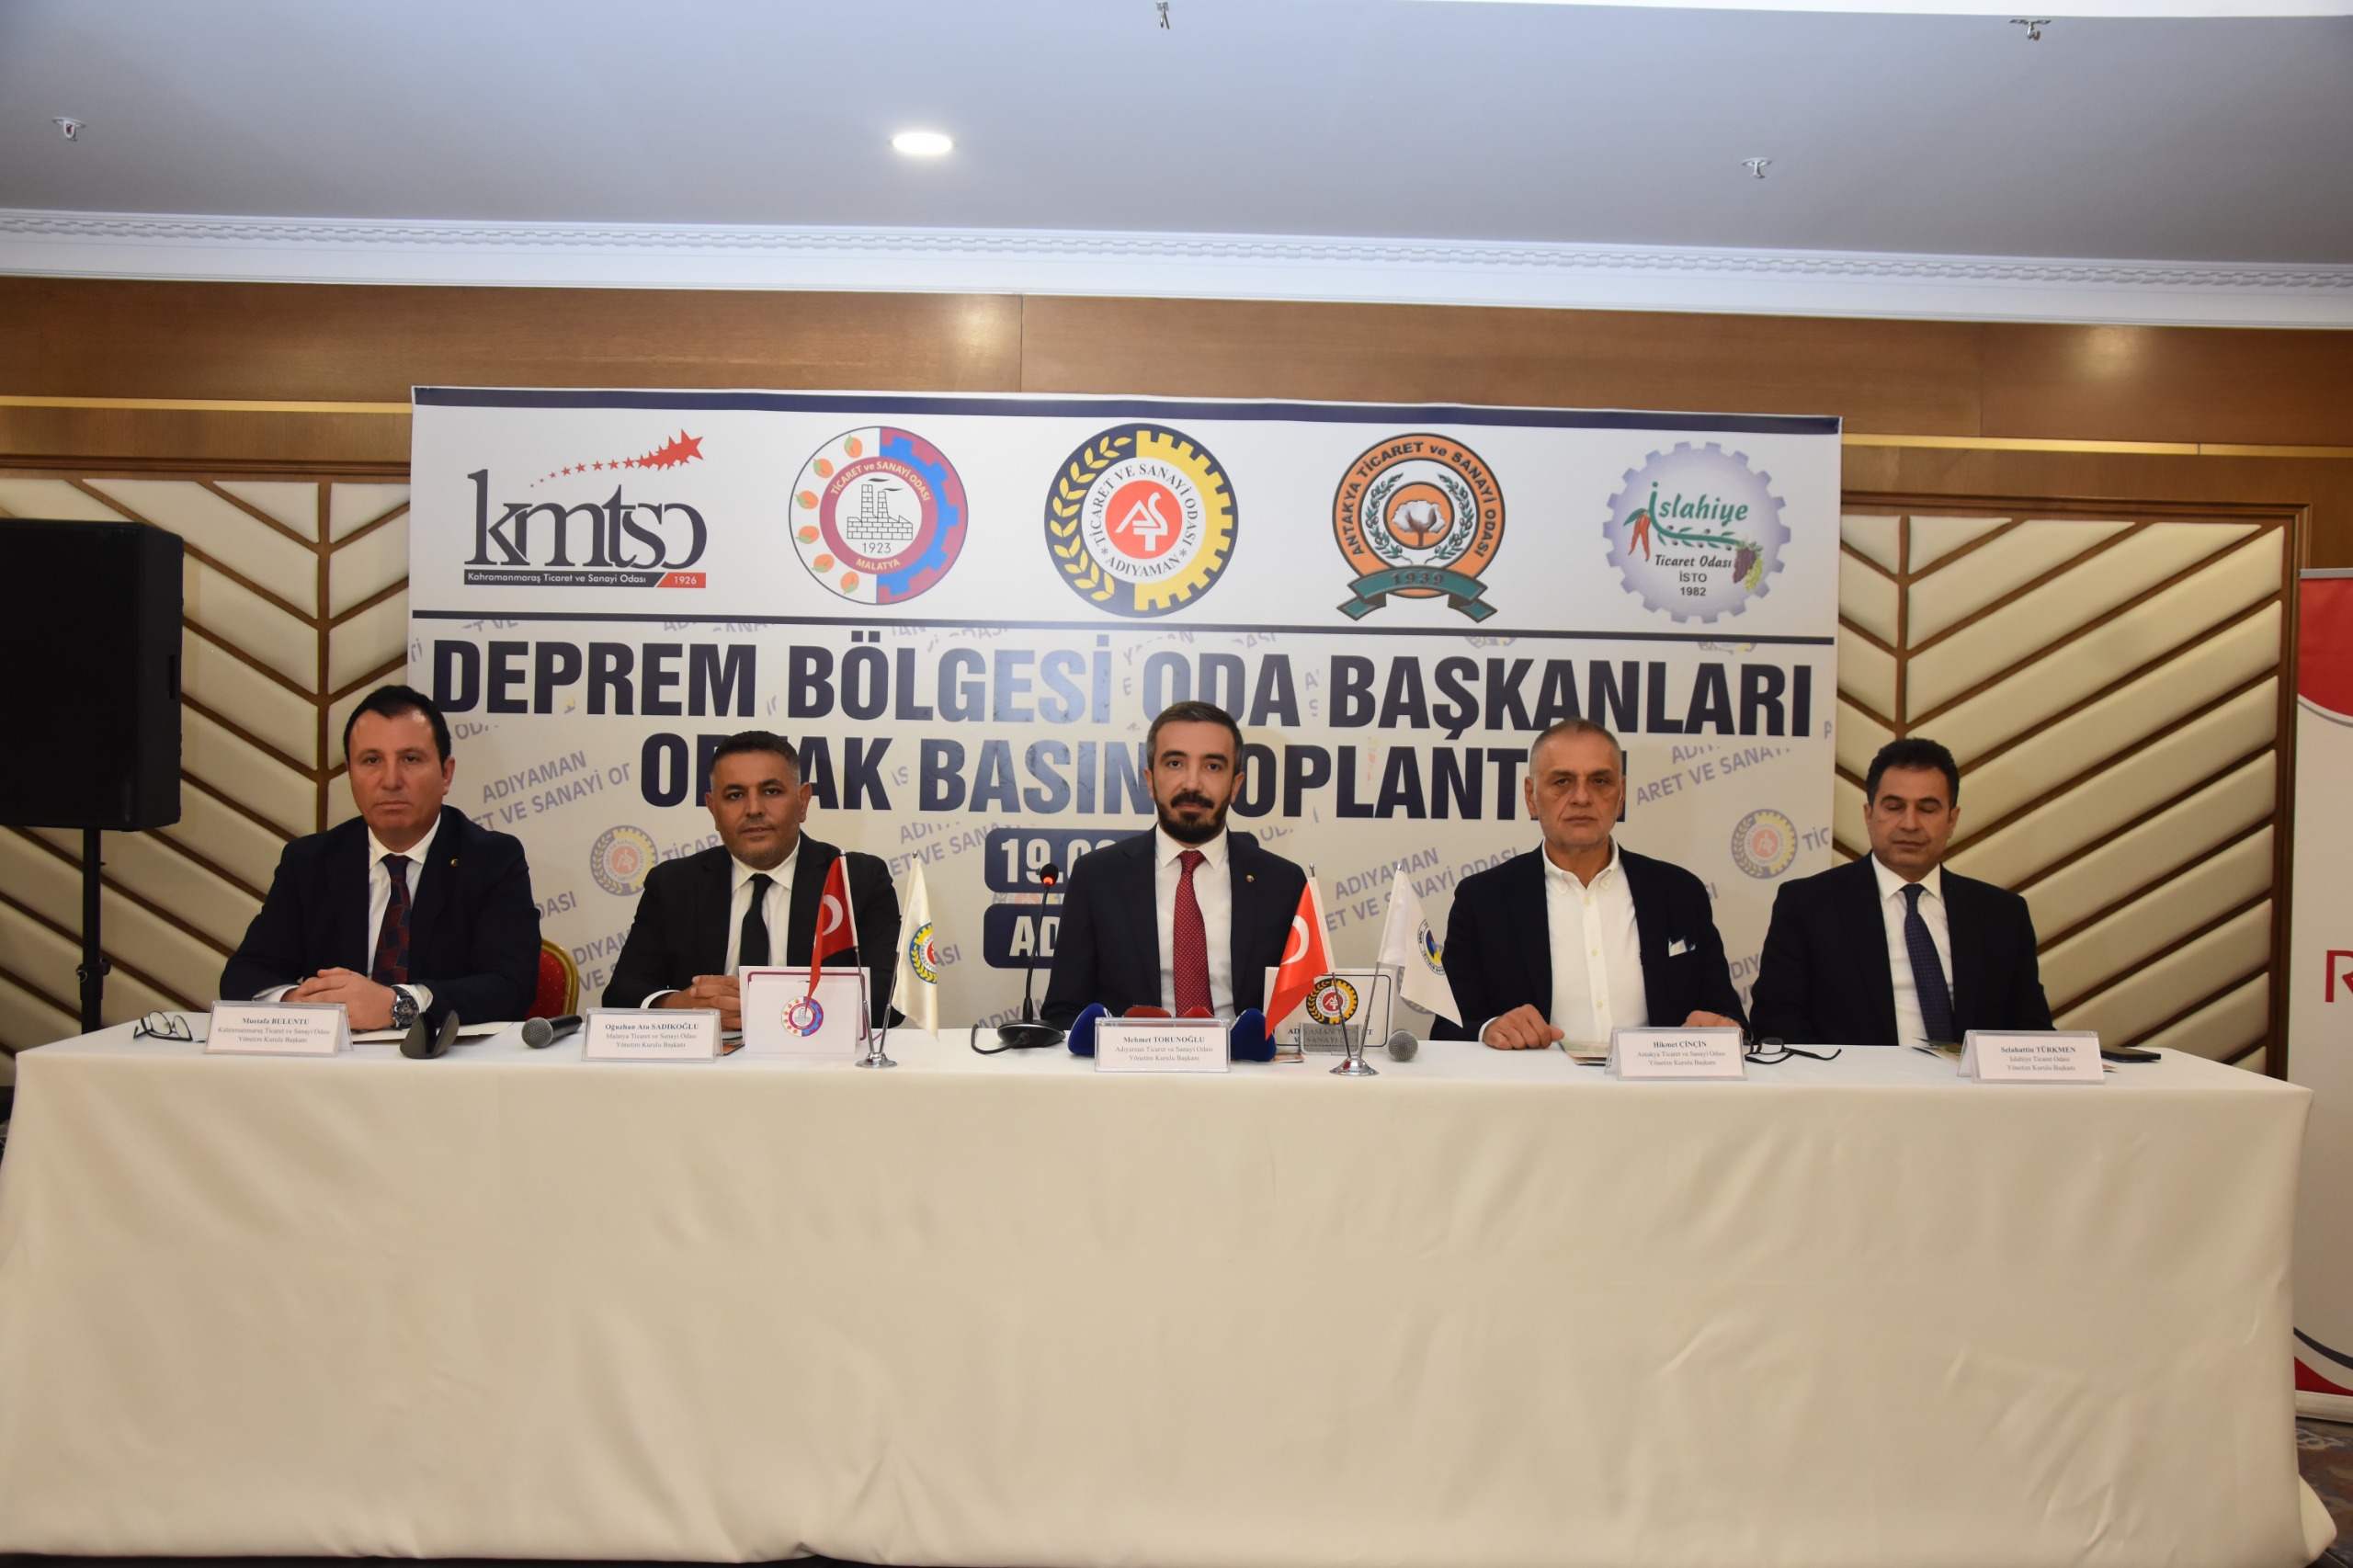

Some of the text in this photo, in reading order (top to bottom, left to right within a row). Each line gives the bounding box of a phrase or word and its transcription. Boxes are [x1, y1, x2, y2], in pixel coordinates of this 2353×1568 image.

[830, 465, 862, 495] TİCARET
[876, 460, 911, 477] SANAYİ
[909, 474, 931, 501] ODASI
[1089, 463, 1199, 546] TİCARET VE SANAYİ ODASI
[1342, 441, 1498, 558] ANTAKYA TİCARET ve SANAYİ ODASI
[862, 542, 892, 554] 1923
[856, 558, 901, 571] MALATYA
[1105, 553, 1181, 577] ADIYAMAN
[1654, 554, 1733, 568] Ticaret Odası
[468, 572, 541, 584] Kahramanmaraş
[543, 574, 573, 583] Ticaret
[588, 574, 618, 585] Sanayi
[620, 574, 646, 584] Odası
[674, 575, 697, 585] 1926
[1391, 571, 1445, 585] 1939
[1679, 571, 1707, 583] İSTO
[1680, 586, 1707, 597] 1982
[432, 639, 756, 717] DEPREM
[788, 630, 1112, 724] BÖLGESİ
[1142, 651, 1301, 727] ODA
[1329, 654, 1812, 739] BAŞKANLARI
[483, 750, 587, 804] ADIYAMAN
[1688, 762, 1716, 785] VE
[499, 801, 528, 824] VE
[531, 769, 604, 813] SANAYİ
[917, 842, 945, 866] VE
[1351, 897, 1381, 922] VE
[293, 1028, 313, 1036] Sanayi
[605, 1023, 636, 1031] Oğuzhan
[651, 1022, 699, 1030] SADIKOĞLU
[1153, 1035, 1205, 1043] TORUNOĞLU
[1678, 1040, 1707, 1049] ÇİNÇİN
[2035, 1045, 2076, 1053] TÜRKMEN
